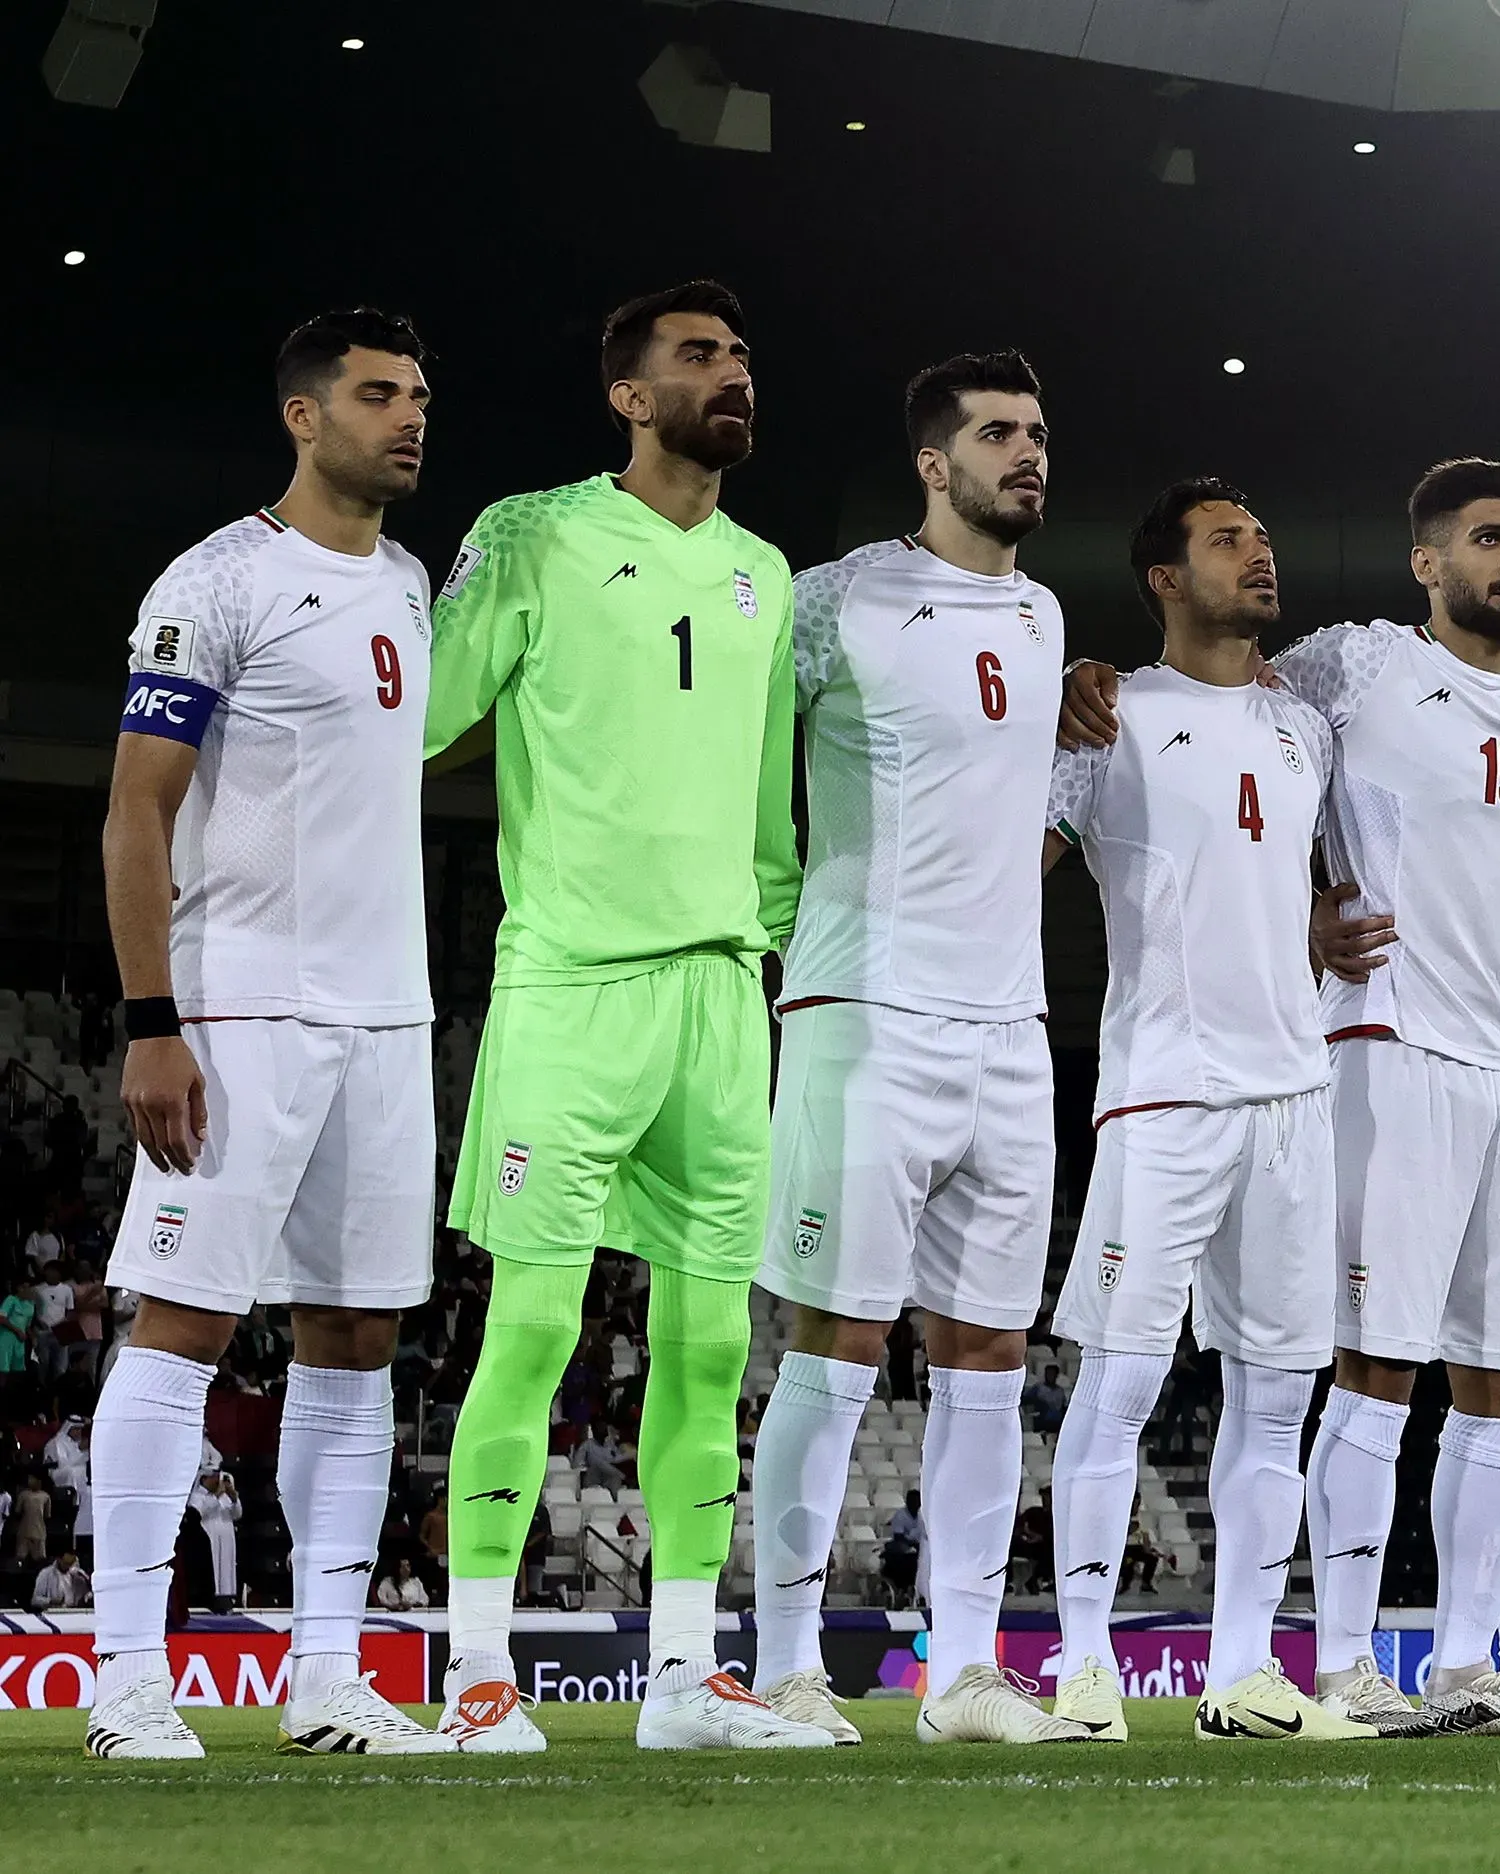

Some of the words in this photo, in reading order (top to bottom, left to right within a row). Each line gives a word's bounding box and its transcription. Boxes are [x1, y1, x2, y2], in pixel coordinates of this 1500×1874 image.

[371, 635, 402, 709] 9
[670, 615, 692, 691] 1
[977, 652, 1006, 720] 6
[123, 686, 193, 724] AFC
[1238, 773, 1264, 841] 4
